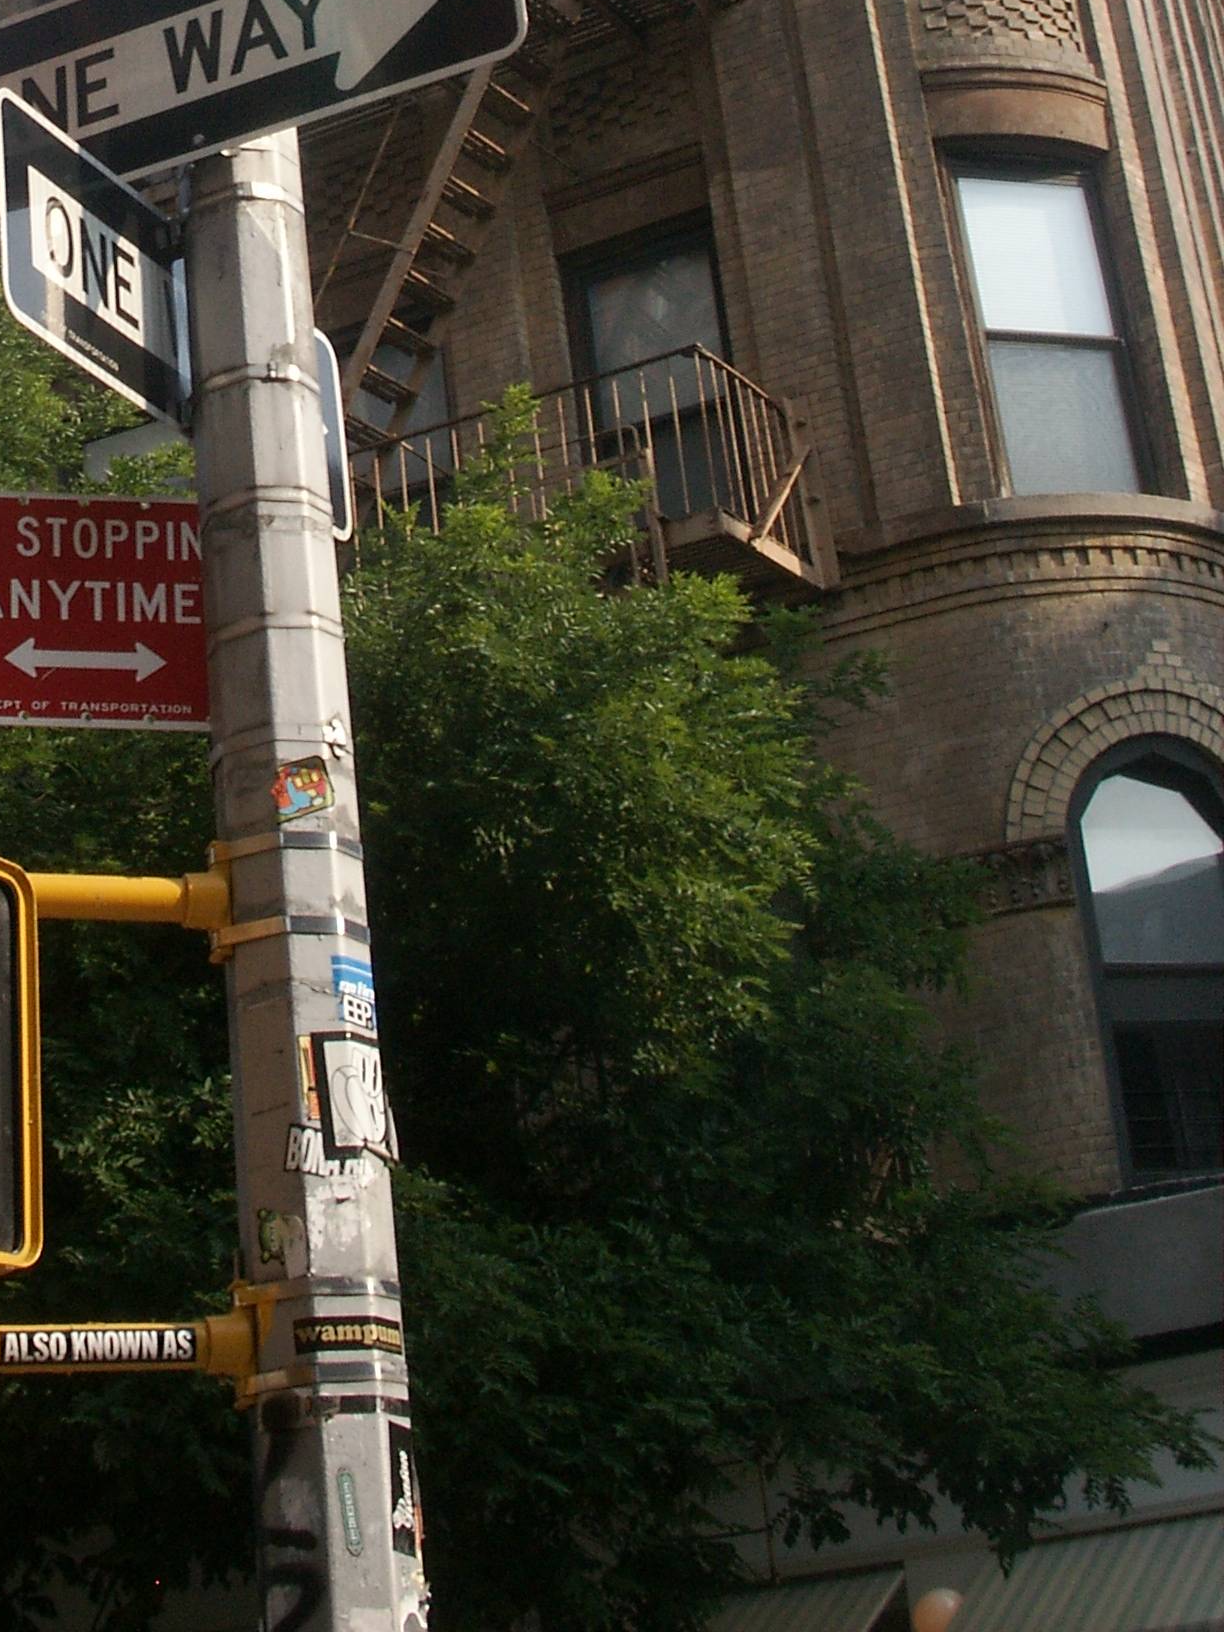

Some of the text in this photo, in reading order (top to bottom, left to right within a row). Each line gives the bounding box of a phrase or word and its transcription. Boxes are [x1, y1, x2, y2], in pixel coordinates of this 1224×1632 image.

[45, 195, 141, 331] ONE
[15, 516, 203, 561] STOPPIN
[31, 700, 51, 710] OF
[61, 701, 192, 714] TRANSPORTATION
[4, 1329, 194, 1363] ALSO KNOWN AS
[298, 1322, 401, 1346] wampum
